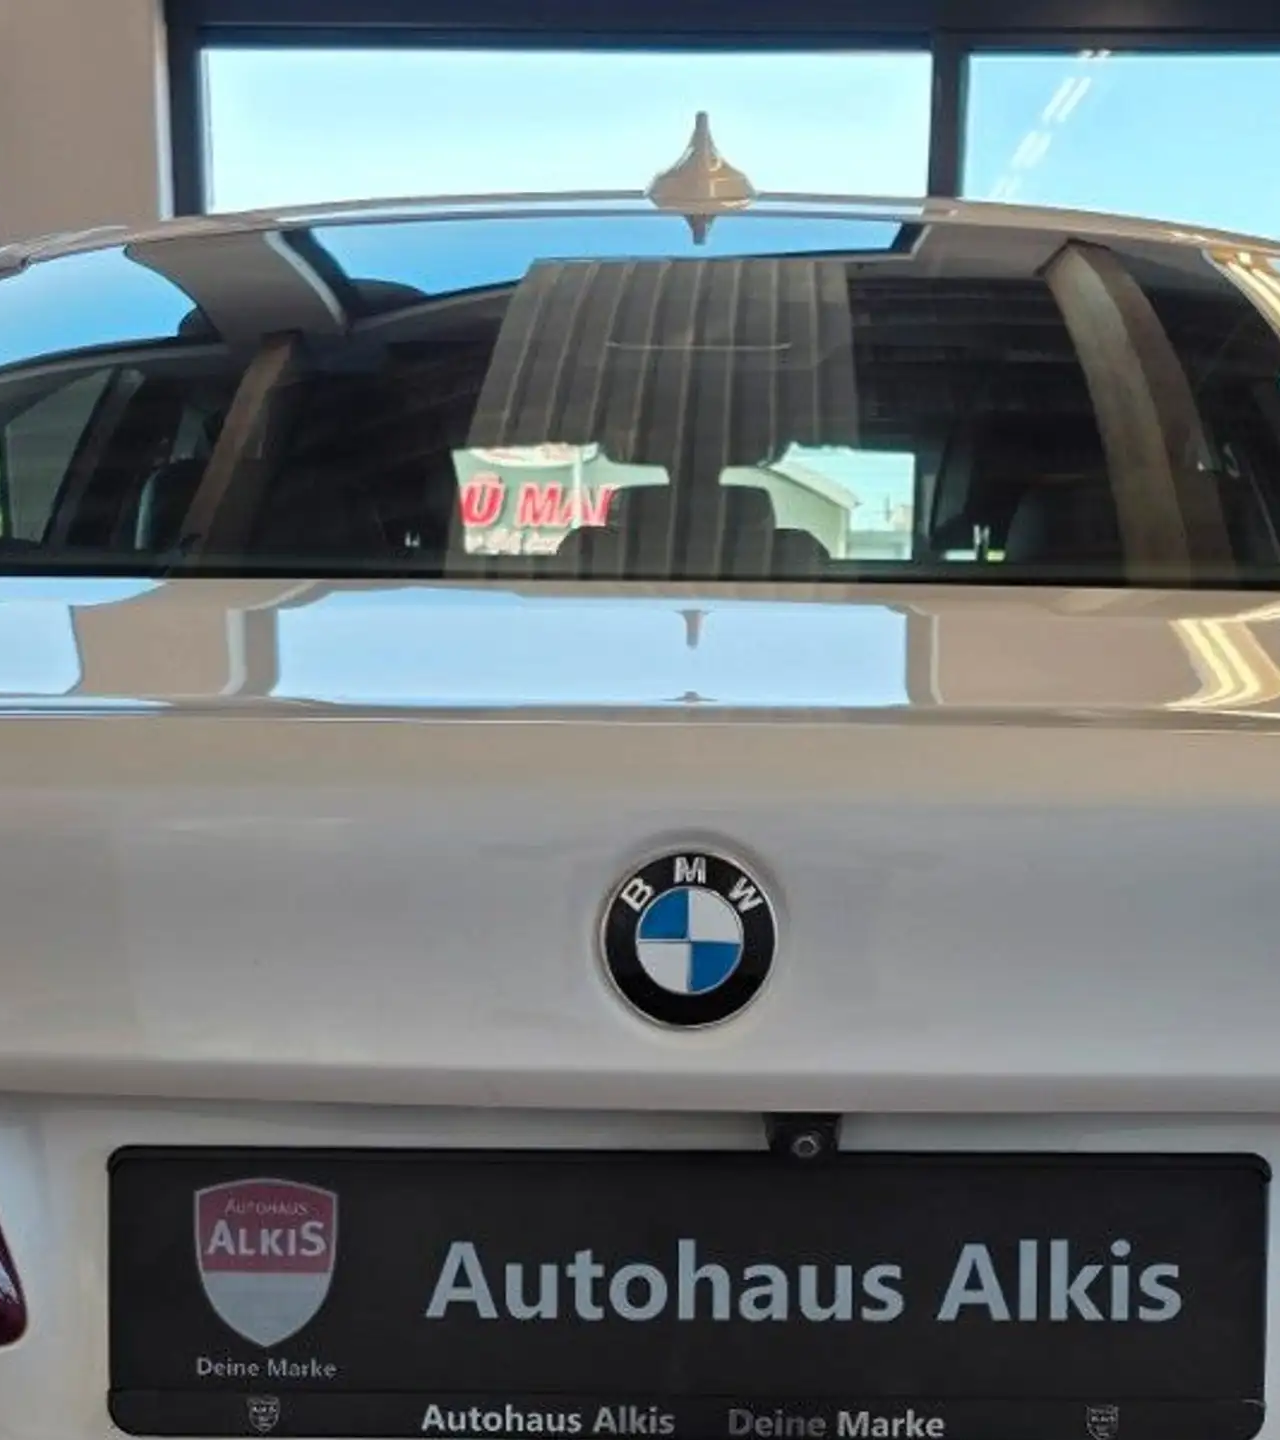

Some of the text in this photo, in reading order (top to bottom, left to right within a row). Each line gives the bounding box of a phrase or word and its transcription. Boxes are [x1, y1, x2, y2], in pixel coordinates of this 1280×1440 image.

[620, 857, 764, 913] BMW
[424, 1239, 1182, 1323] Autohaus Alkis
[196, 1356, 338, 1379] Deine Marke
[420, 1404, 946, 1439] Autohaus Alkis Deine Marke
